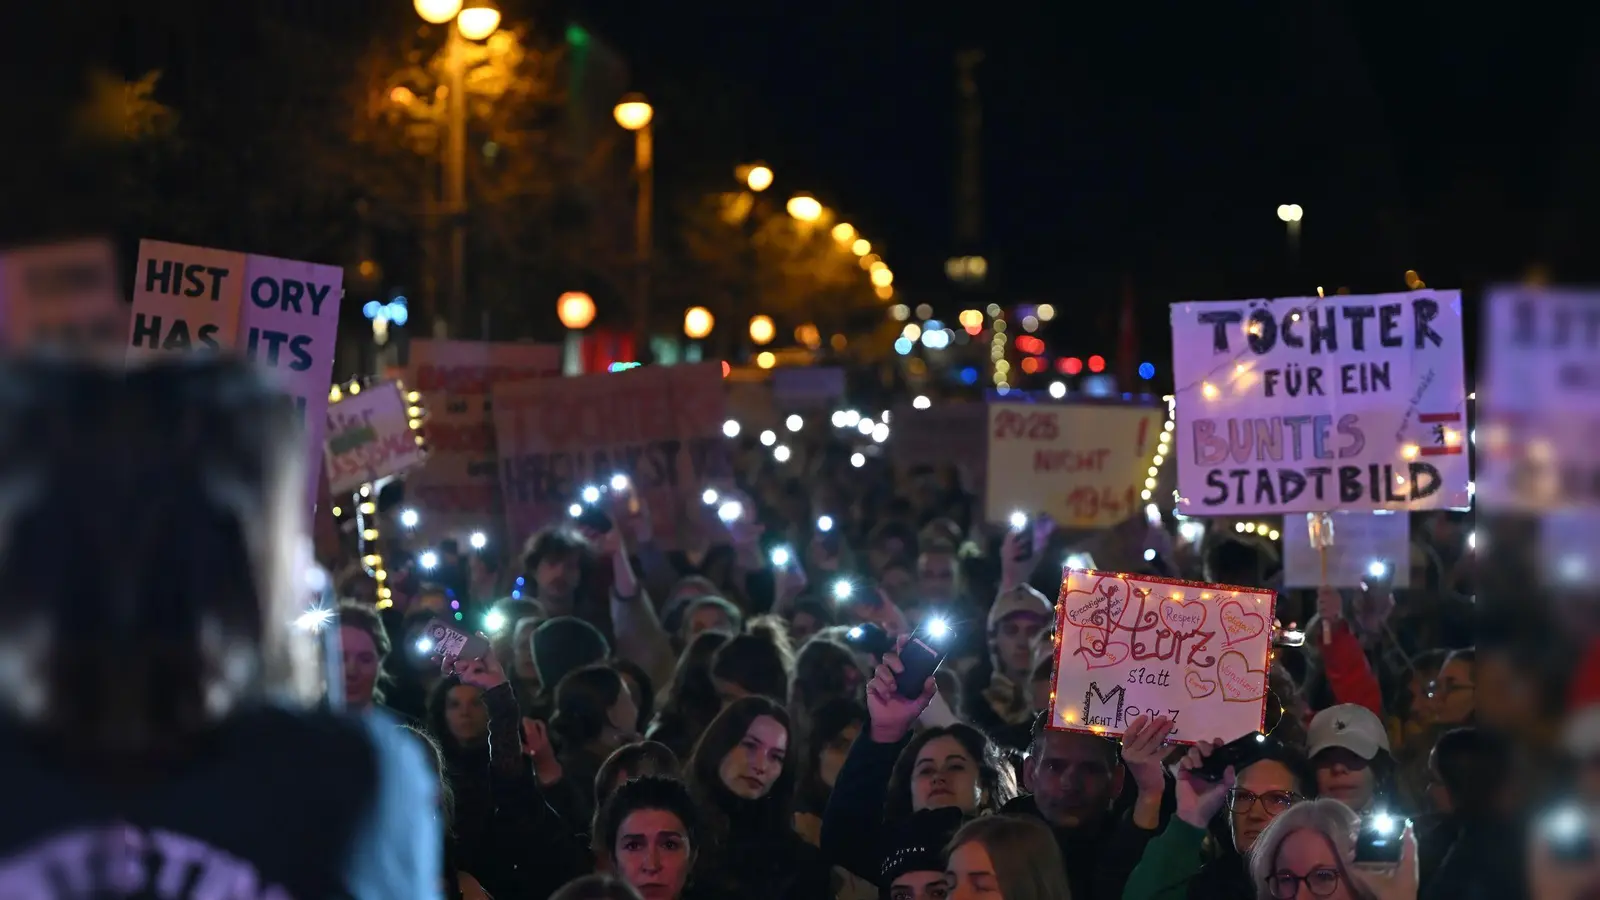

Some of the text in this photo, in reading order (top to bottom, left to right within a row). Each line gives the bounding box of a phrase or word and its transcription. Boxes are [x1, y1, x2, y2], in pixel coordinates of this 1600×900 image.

[132, 312, 314, 372] HAS ITS
[1197, 298, 1444, 356] TÖCHTER
[1263, 360, 1392, 398] FÜR EIN
[994, 408, 1060, 441] 2025
[1193, 413, 1367, 467] BUNTES
[1034, 447, 1112, 474] NICHT
[1202, 462, 1444, 507] STADTBILD
[1073, 584, 1217, 669] Herz
[1165, 606, 1201, 628] Respekt
